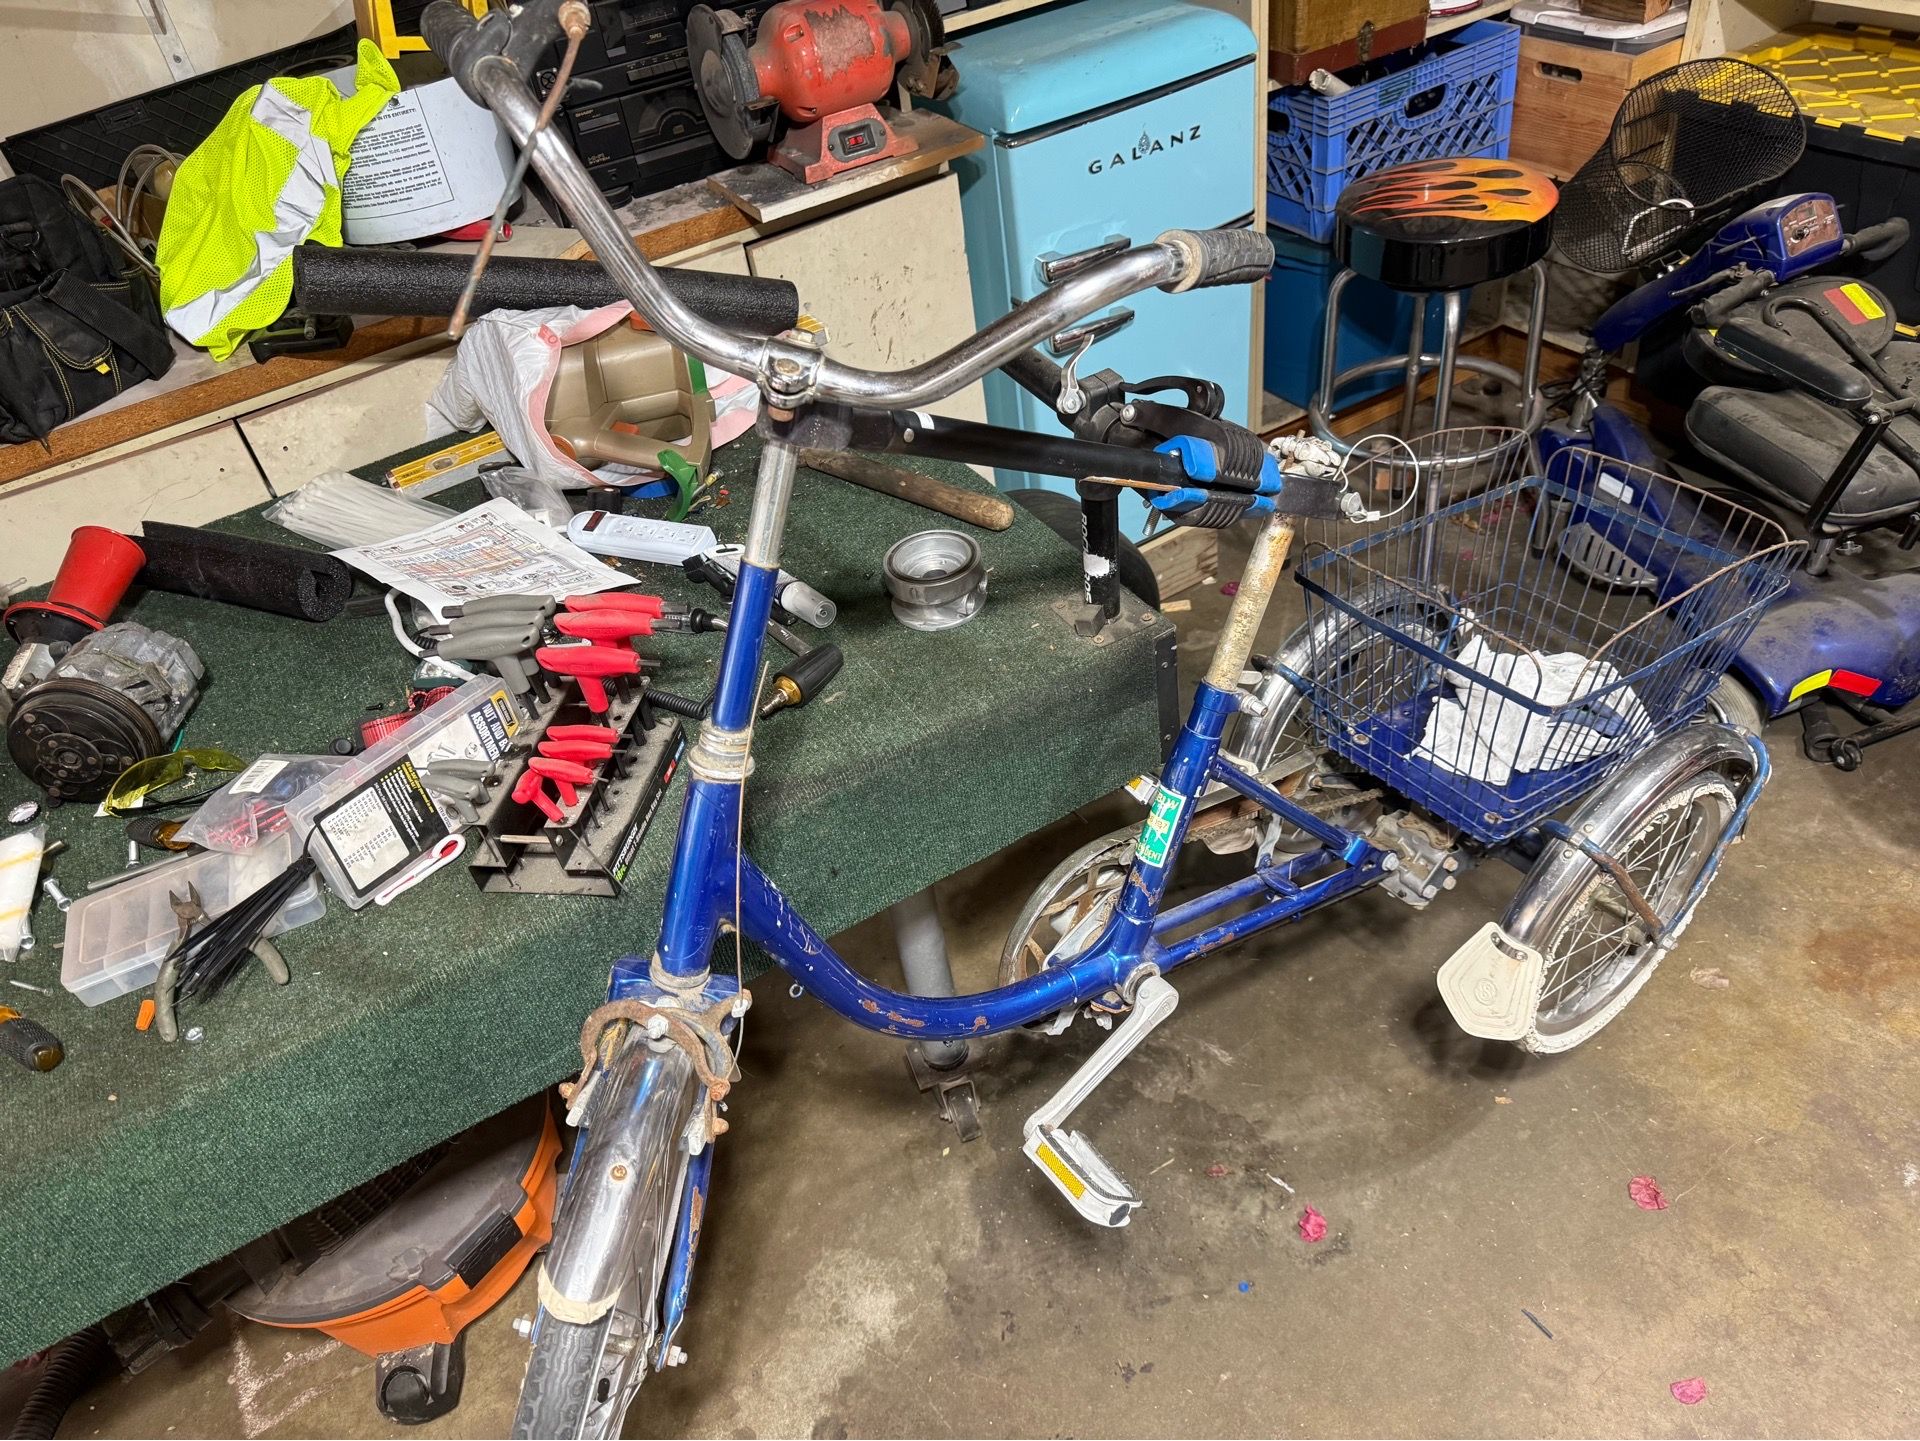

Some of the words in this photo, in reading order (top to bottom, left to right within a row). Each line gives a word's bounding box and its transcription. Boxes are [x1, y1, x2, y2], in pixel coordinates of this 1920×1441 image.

[1088, 125, 1200, 174] GALANZ
[470, 711, 501, 763] ASSORTMEN
[482, 702, 497, 722] NUT
[490, 721, 505, 740] AND
